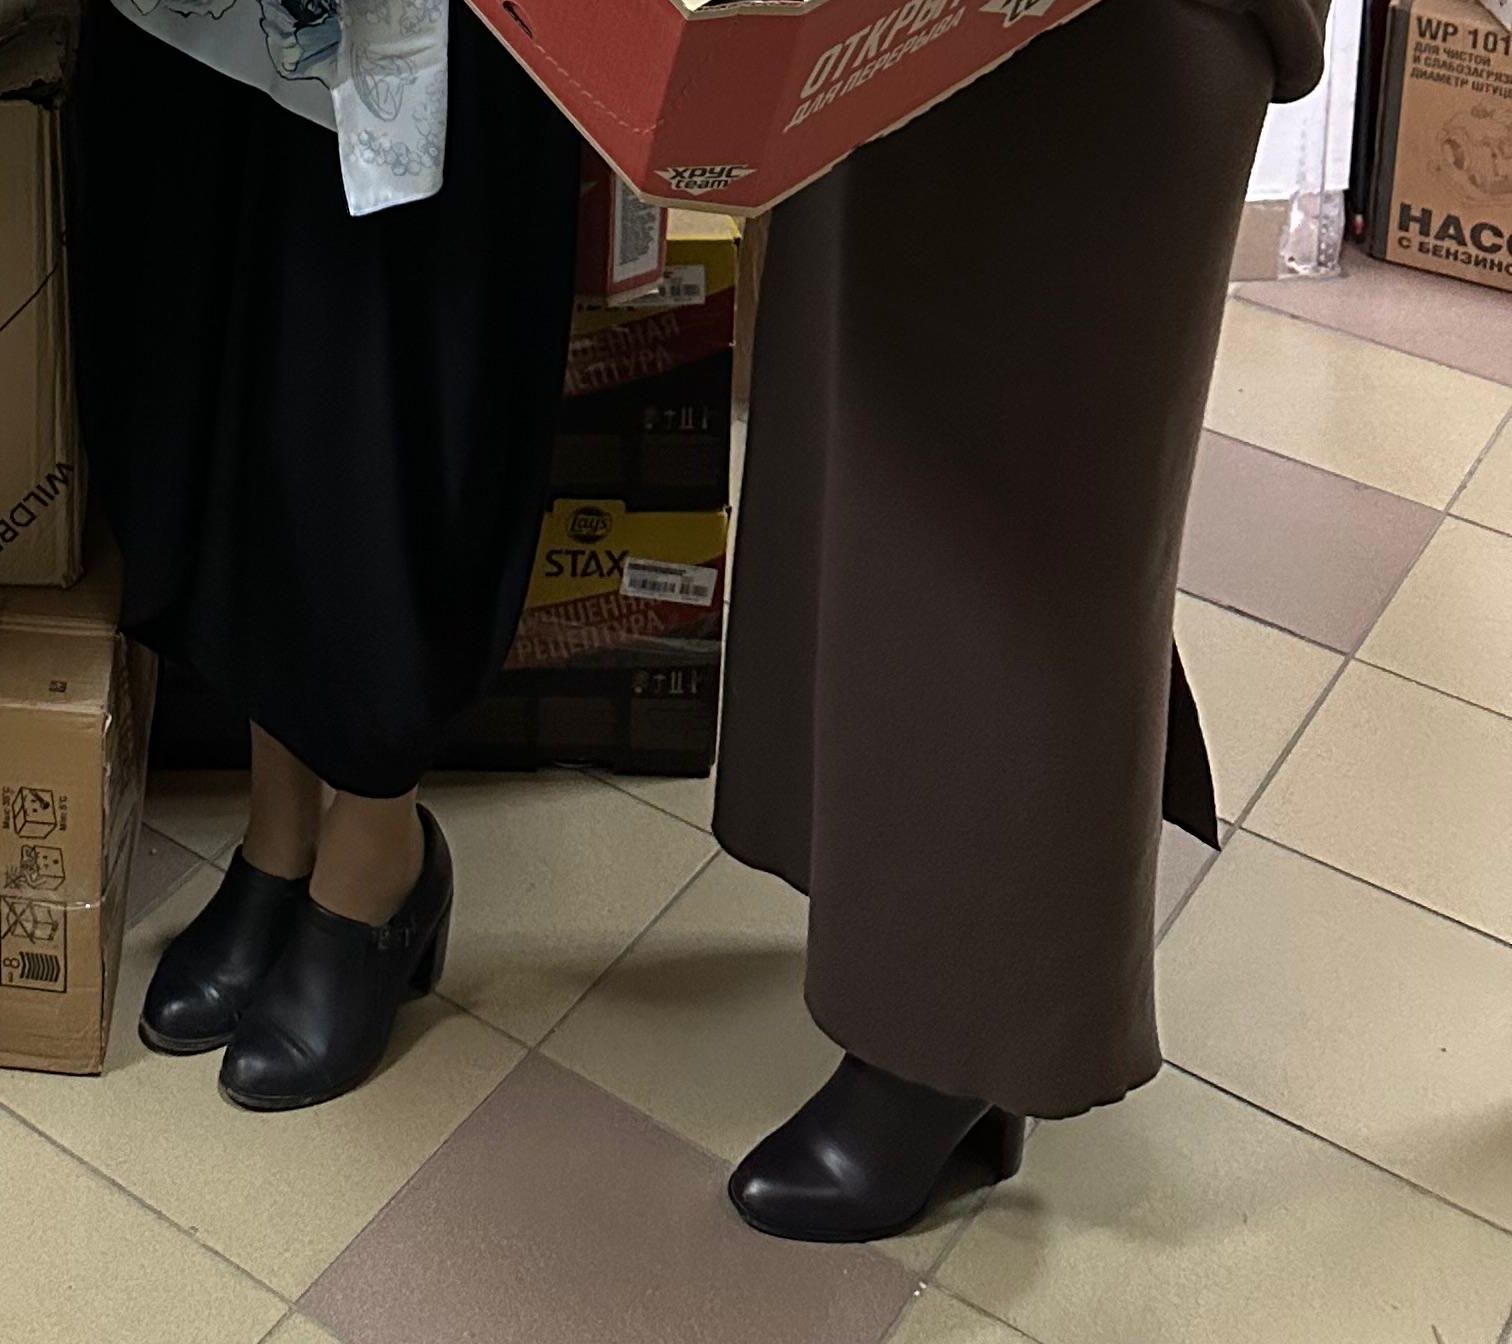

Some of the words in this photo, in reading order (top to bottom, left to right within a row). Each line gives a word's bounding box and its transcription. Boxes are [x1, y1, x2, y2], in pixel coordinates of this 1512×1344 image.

[1415, 15, 1458, 43] WP
[1414, 42, 1439, 57] ДЛЯ
[1443, 46, 1491, 67] ЧИСТОЙ
[783, 81, 843, 133] ДЛЯ
[841, 7, 966, 97] ПЕРЕРЫВА
[1410, 67, 1469, 90] ДИАМЕТР
[675, 179, 729, 190] team
[545, 549, 630, 578] STAX
